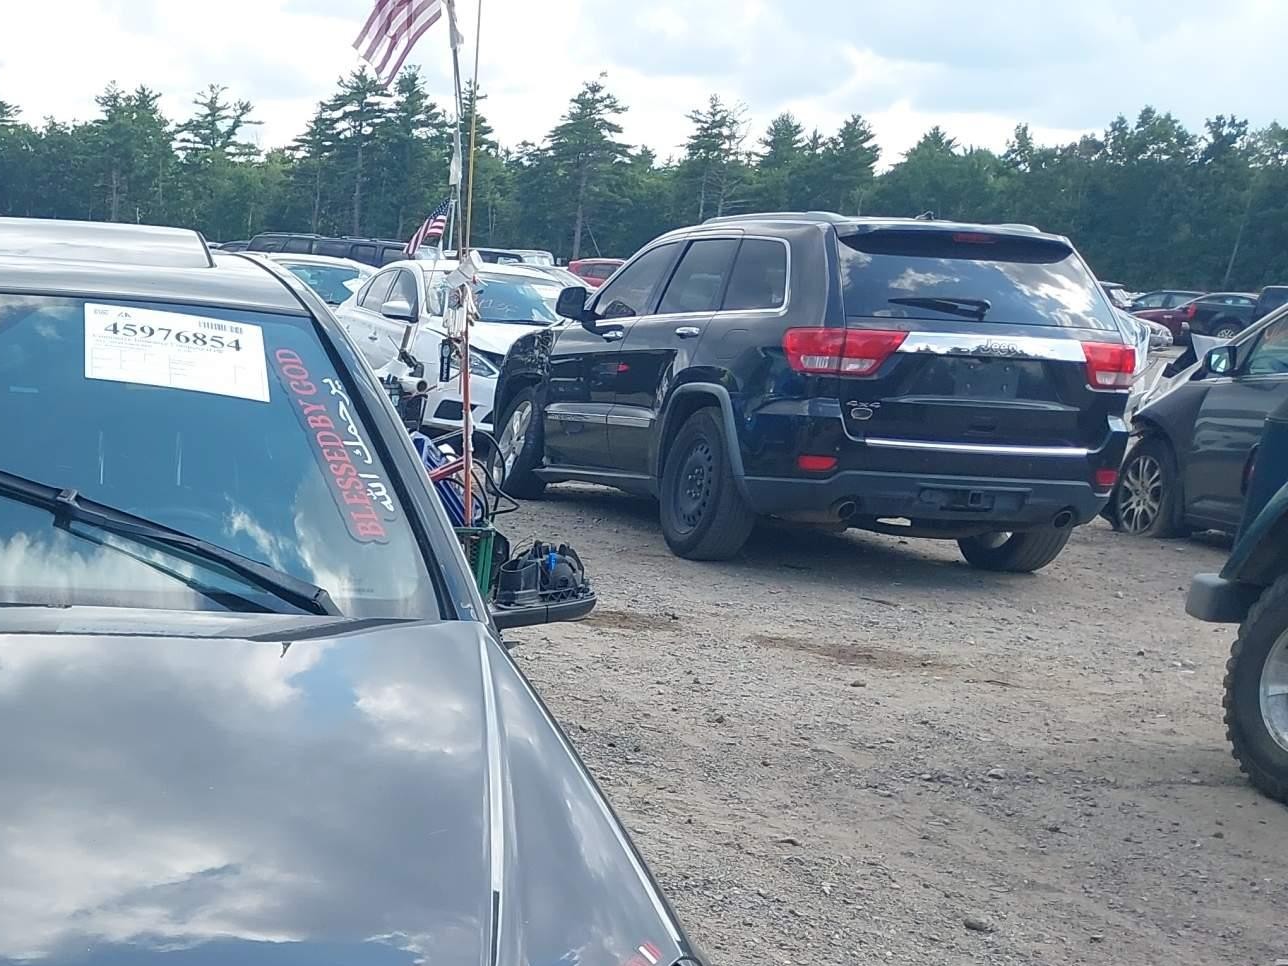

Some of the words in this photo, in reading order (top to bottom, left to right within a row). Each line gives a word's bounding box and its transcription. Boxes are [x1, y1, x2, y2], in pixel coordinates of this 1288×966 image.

[104, 320, 243, 353] 45976854
[980, 338, 1018, 357] Jeep
[275, 347, 319, 396] GOD
